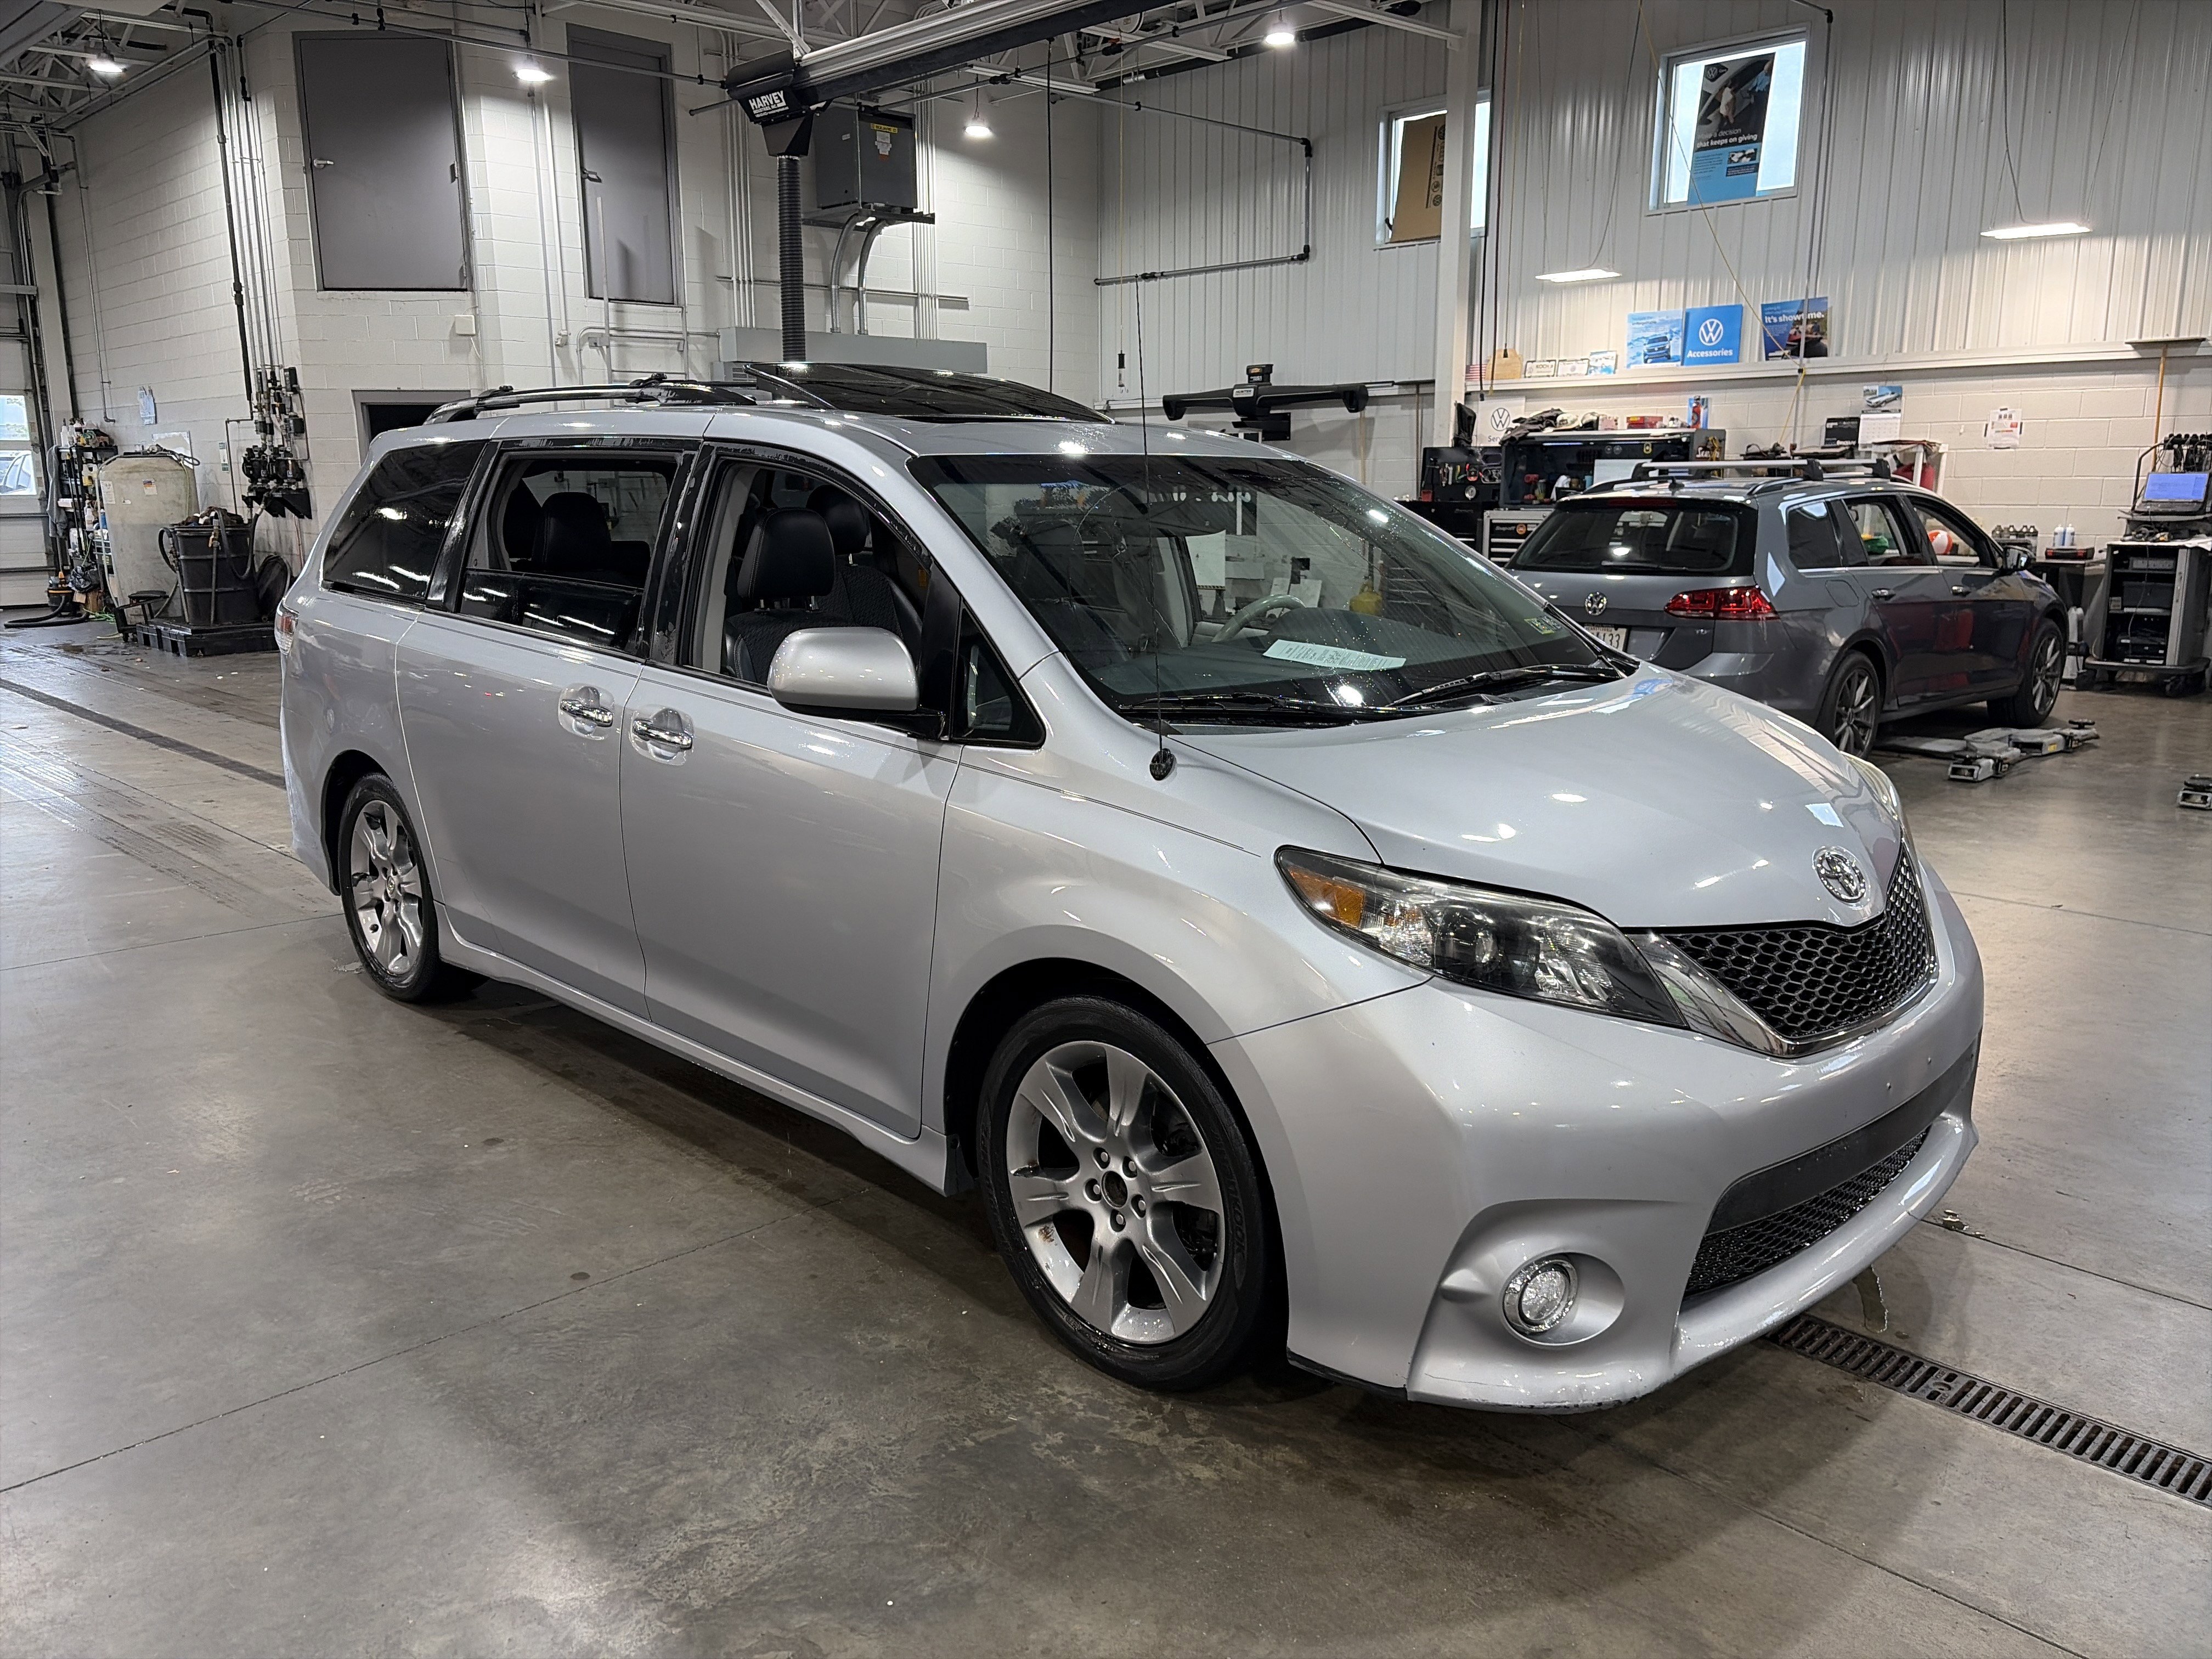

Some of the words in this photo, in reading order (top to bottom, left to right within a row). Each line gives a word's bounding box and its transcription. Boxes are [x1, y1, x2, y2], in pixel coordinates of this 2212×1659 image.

[748, 90, 787, 110] HARVEY
[1718, 128, 1741, 137] decision
[1710, 138, 1728, 146] keeps
[1738, 133, 1758, 143] giving
[1764, 315, 1778, 324] It's
[1778, 311, 1825, 323] showtme.
[1687, 348, 1733, 358] Accessories
